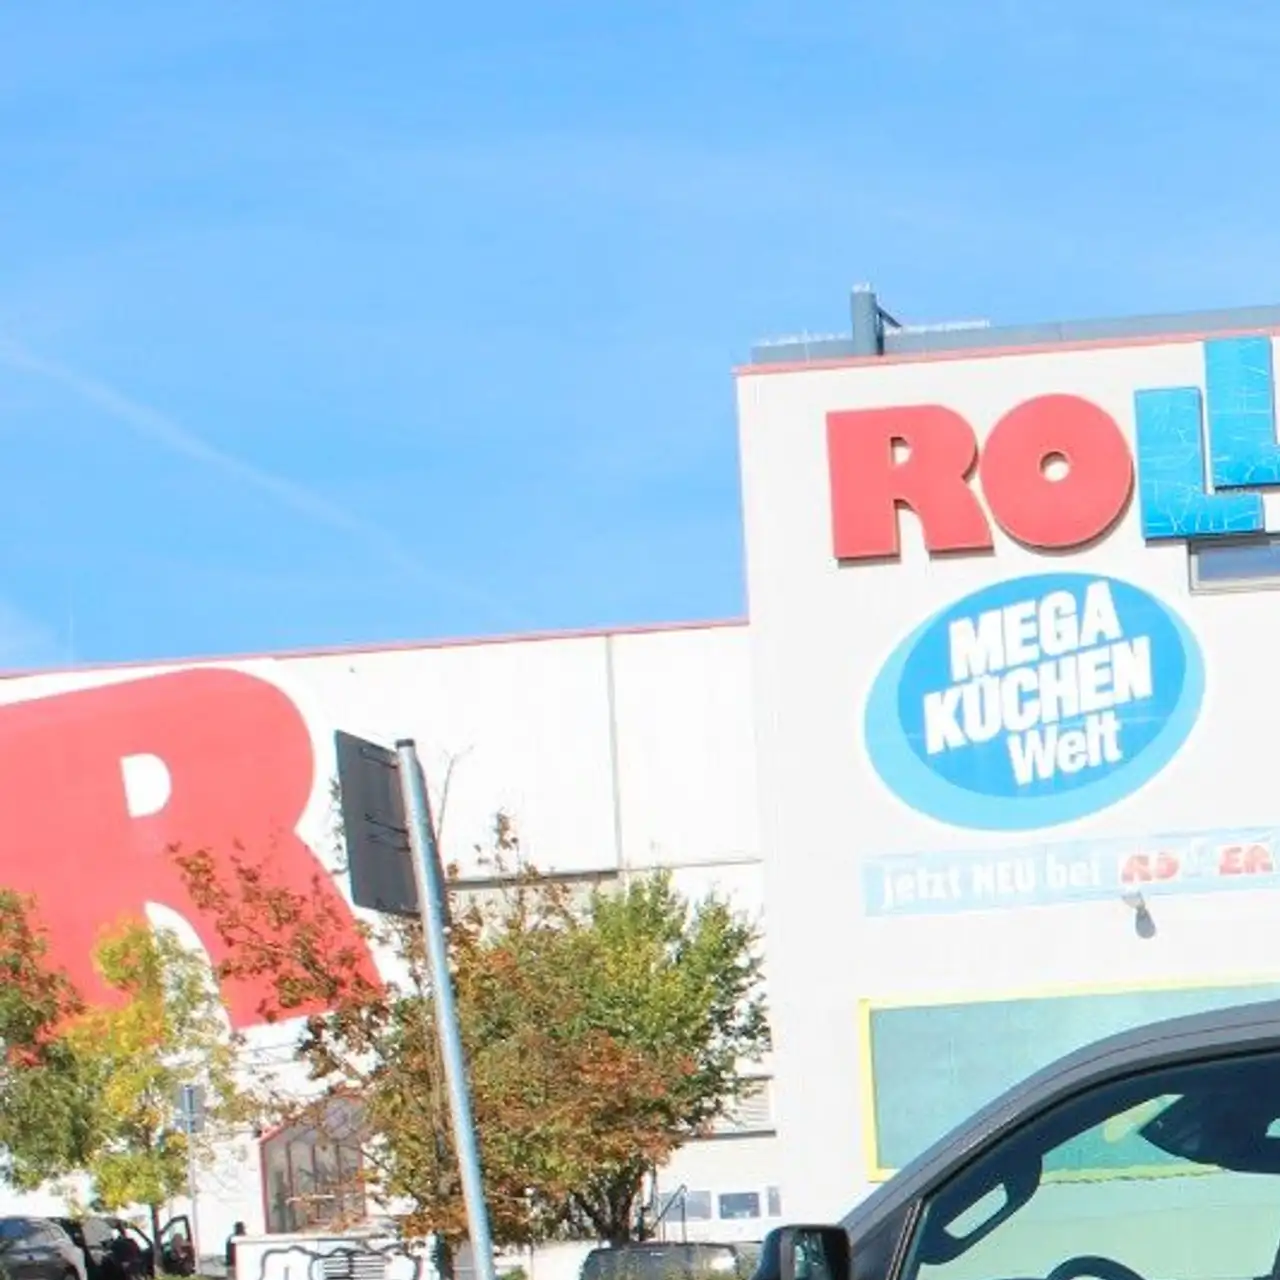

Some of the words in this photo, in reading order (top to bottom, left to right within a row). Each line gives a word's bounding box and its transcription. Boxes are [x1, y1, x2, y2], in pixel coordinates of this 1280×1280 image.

[948, 580, 1123, 679] MEGA
[922, 635, 1152, 755] KÜCHEN
[1006, 709, 1124, 786] Welt
[972, 859, 1037, 896] NEU
[1046, 852, 1101, 888] bei
